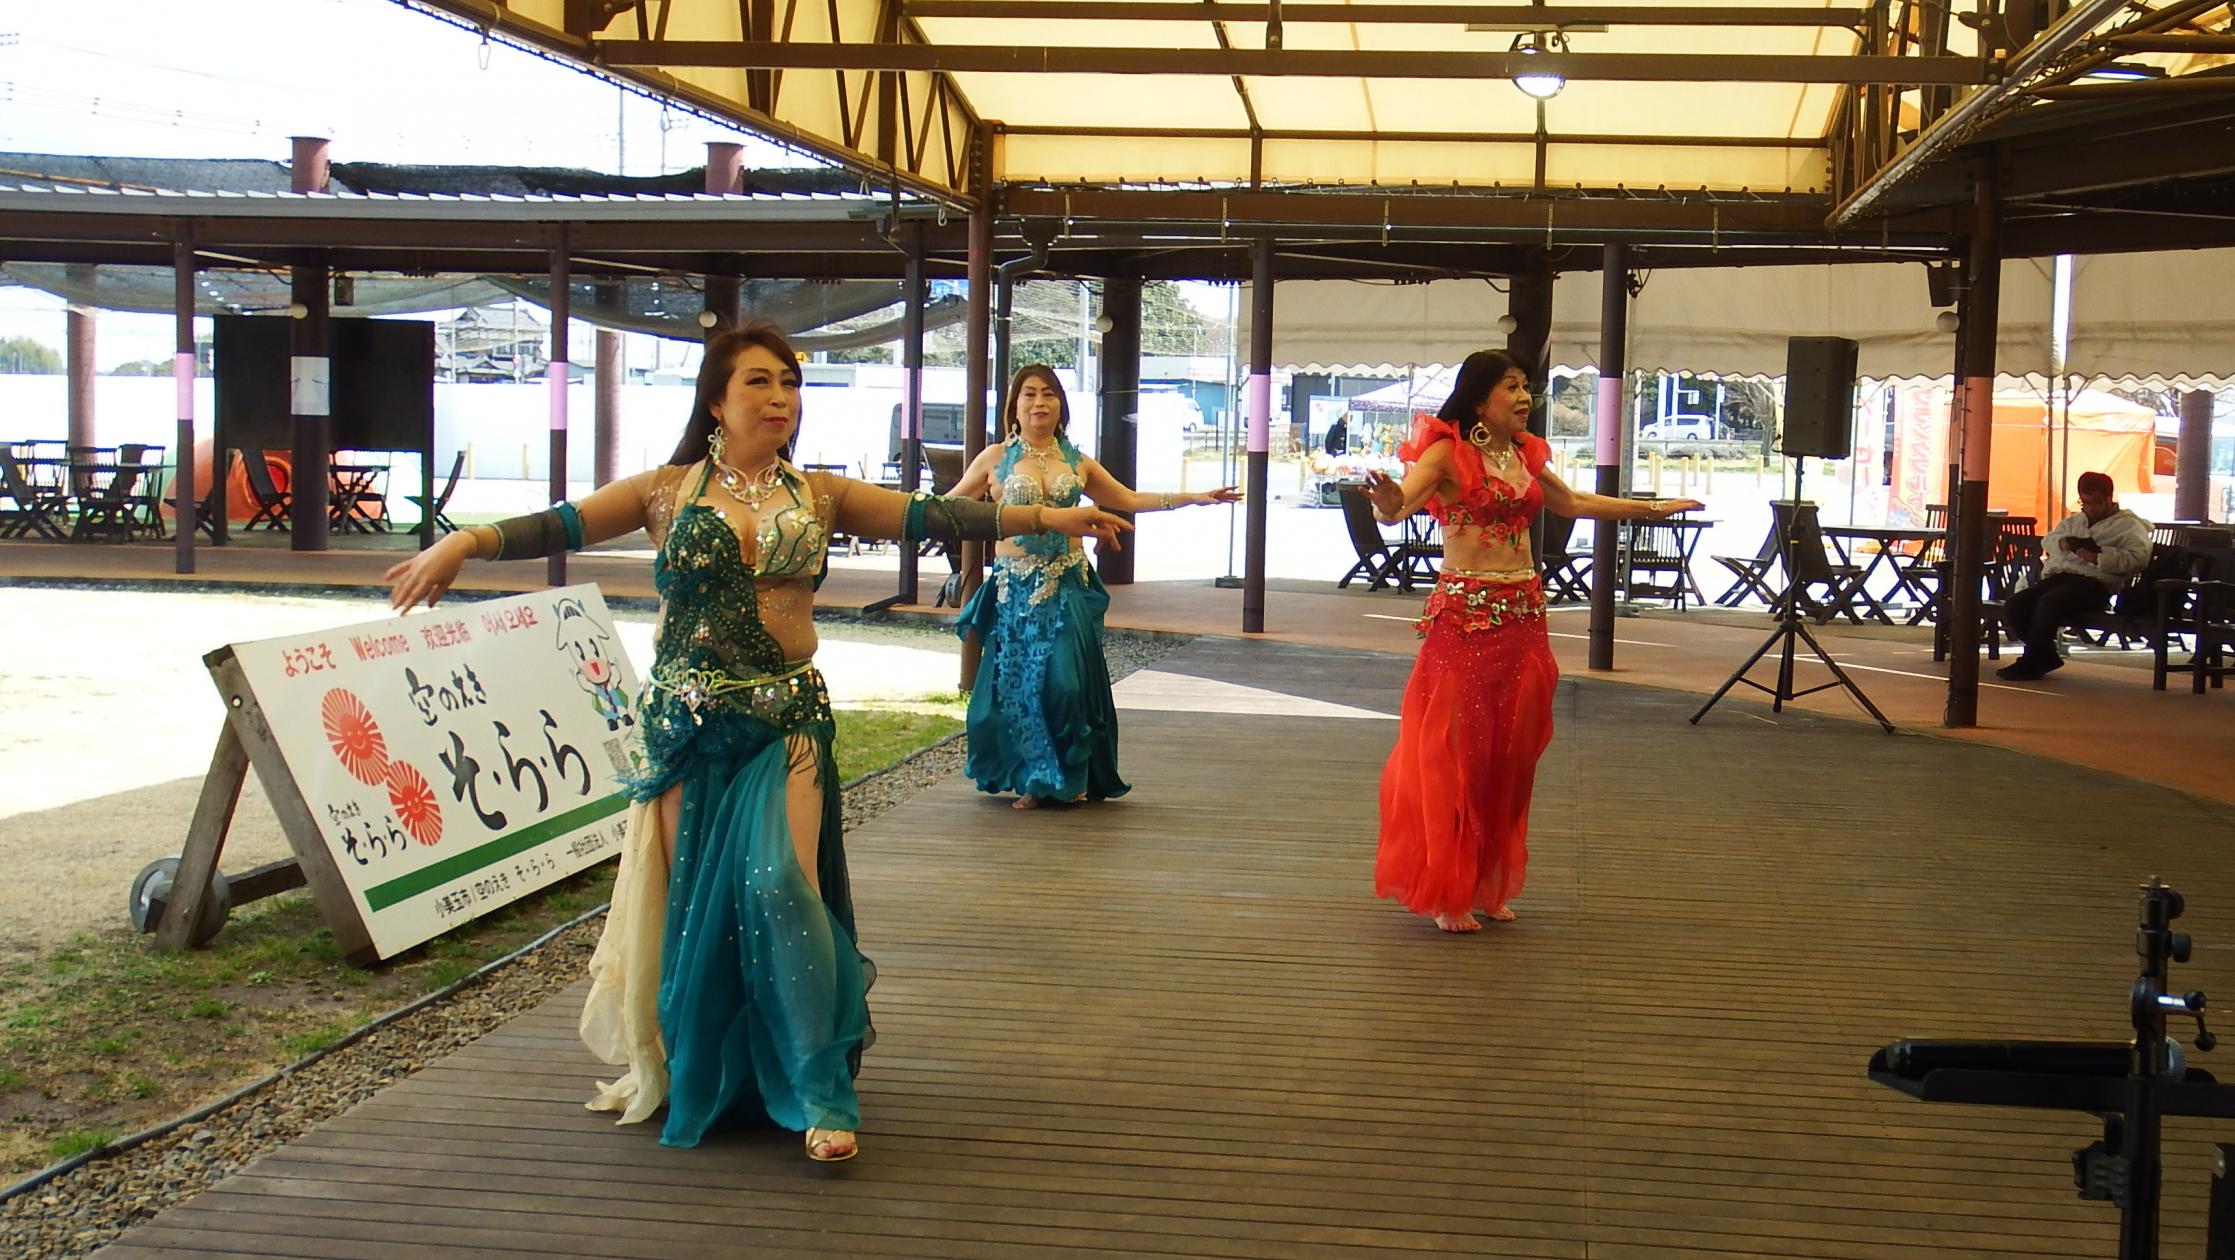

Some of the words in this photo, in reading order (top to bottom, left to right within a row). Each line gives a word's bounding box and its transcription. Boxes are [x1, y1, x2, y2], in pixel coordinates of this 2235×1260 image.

[282, 642, 337, 678] ようこそ
[349, 632, 410, 662] Welcome
[405, 663, 487, 726] 空のえき
